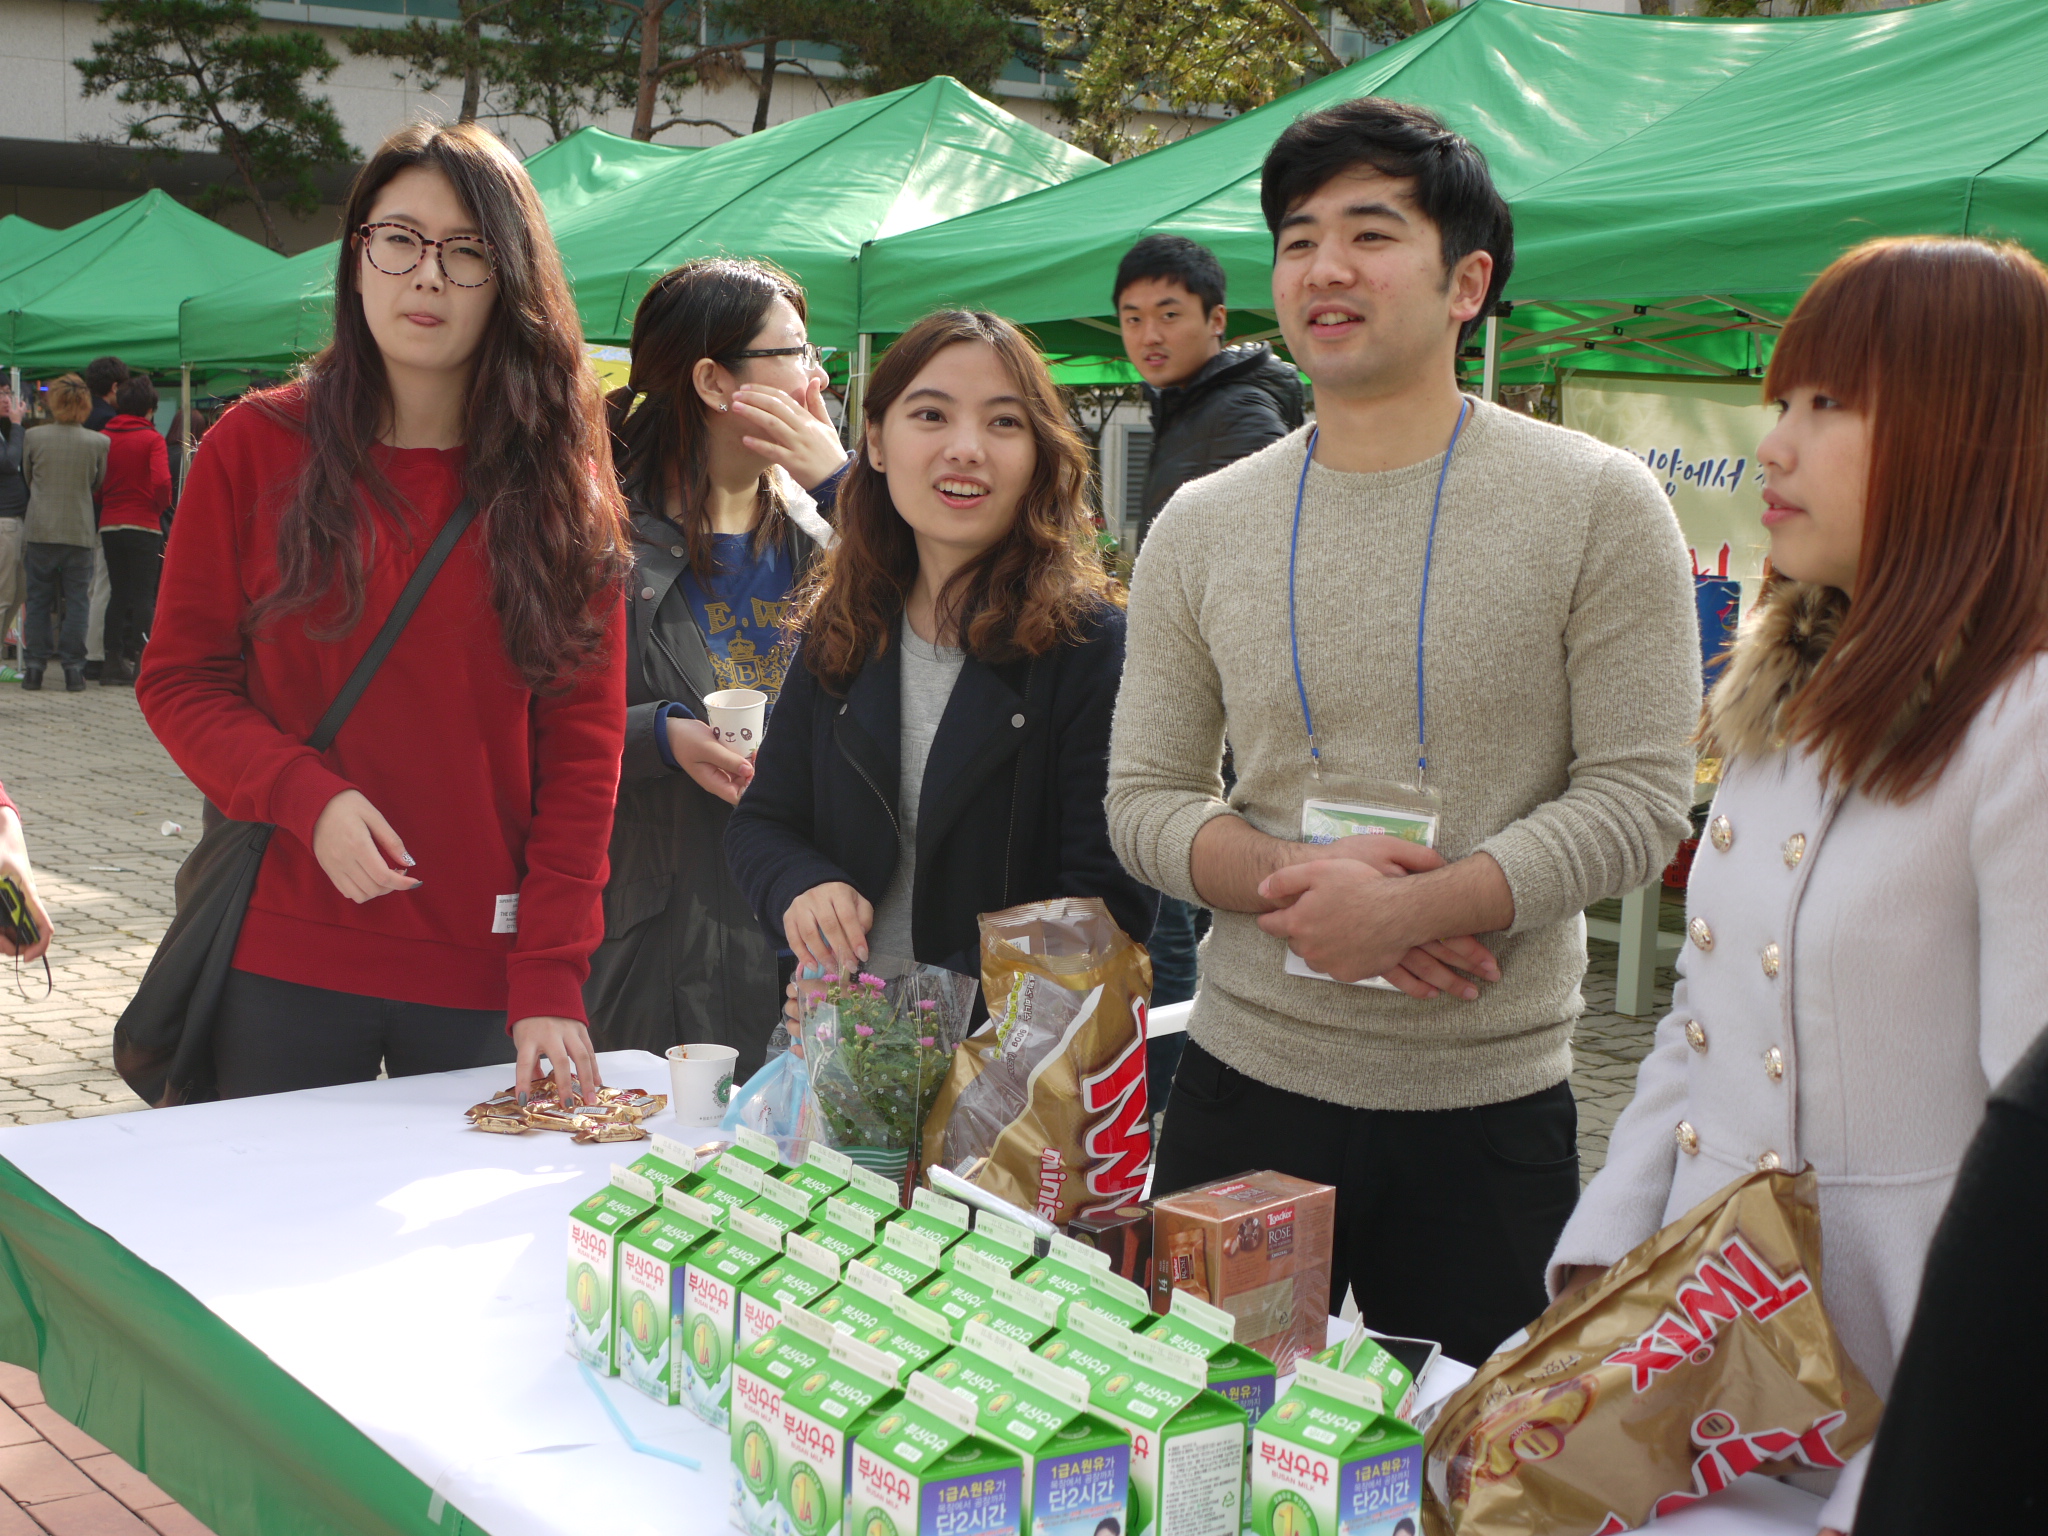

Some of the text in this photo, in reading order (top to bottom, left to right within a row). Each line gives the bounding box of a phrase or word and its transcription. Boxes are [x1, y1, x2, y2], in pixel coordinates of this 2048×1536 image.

[735, 664, 756, 682] B
[1023, 998, 1033, 1021] 미니스
[1011, 1028, 1027, 1048] 900g
[802, 1176, 832, 1194] 부산우유
[1036, 1147, 1067, 1222] minis
[606, 1199, 637, 1217] 부산우유
[1267, 1209, 1294, 1226] Loacker
[572, 1225, 607, 1259] 부산우유
[662, 1224, 695, 1243] 부산우유
[822, 1236, 855, 1256] 부산우유
[1268, 1226, 1292, 1244] ROSE
[626, 1251, 664, 1286] 부산우유
[727, 1246, 760, 1266] 부산우유
[782, 1274, 818, 1296] 부산우유
[881, 1262, 917, 1284] 부산우유
[1159, 1278, 1168, 1293] 14
[689, 1272, 728, 1310] 부산우유
[745, 1302, 782, 1332] 부산우
[842, 1304, 878, 1329] 부산우유
[1602, 1236, 1812, 1393] TWIX
[992, 1318, 1033, 1343] 부산우유
[777, 1344, 816, 1369] 부산우유
[892, 1335, 930, 1360] 부산우유
[1068, 1349, 1110, 1375] 부산우유
[828, 1380, 872, 1407] 부산우유
[1134, 1381, 1182, 1408] 부산우유
[1015, 1401, 1062, 1430] 부산우유
[1307, 1407, 1362, 1434] 부산우유
[783, 1412, 835, 1459] 부산우유
[904, 1423, 948, 1452] 부산우유
[1260, 1441, 1329, 1486] 부산우유
[858, 1456, 911, 1505] 부산우유
